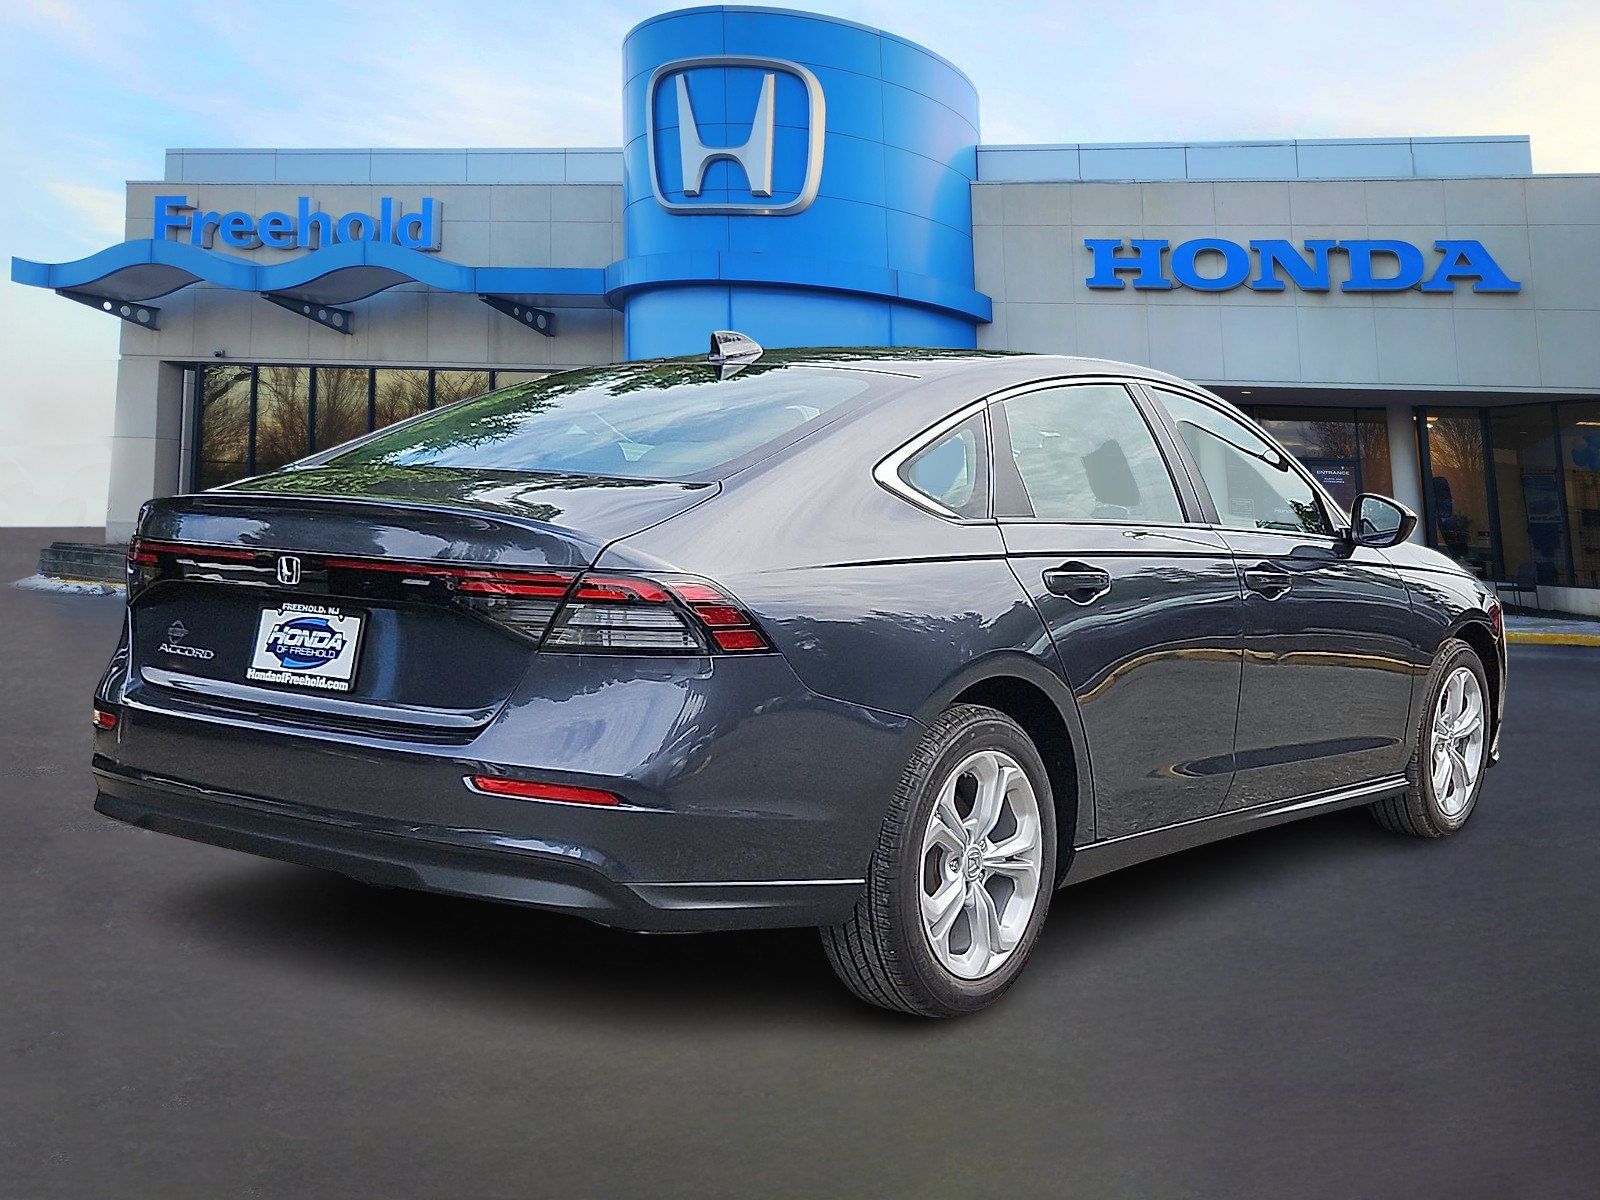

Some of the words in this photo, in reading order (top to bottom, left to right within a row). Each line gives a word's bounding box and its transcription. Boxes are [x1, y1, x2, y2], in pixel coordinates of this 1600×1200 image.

[153, 195, 434, 249] Freehold
[1084, 238, 1521, 293] HONDA
[267, 625, 343, 650] HONDA
[158, 643, 215, 659] ACCORD
[276, 645, 288, 653] OF
[289, 647, 336, 659] FREEHOLD
[246, 668, 349, 691] HondaofFreehold.com
